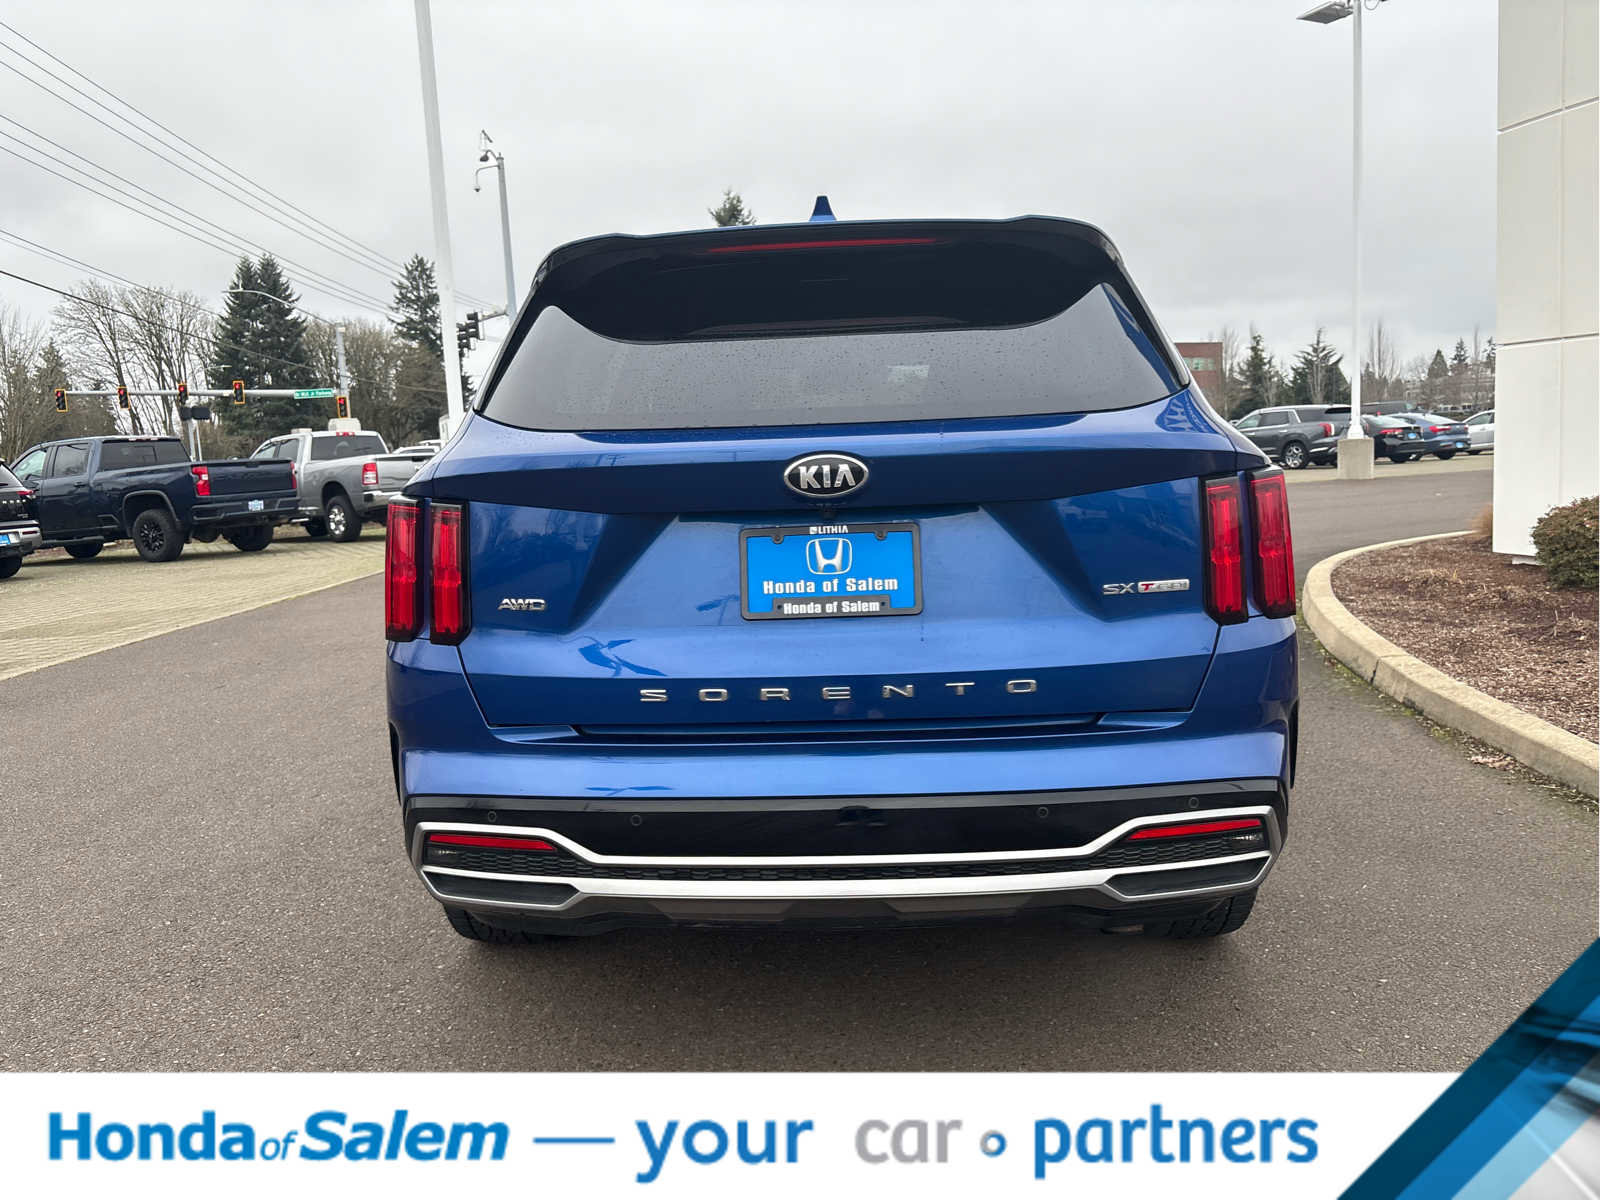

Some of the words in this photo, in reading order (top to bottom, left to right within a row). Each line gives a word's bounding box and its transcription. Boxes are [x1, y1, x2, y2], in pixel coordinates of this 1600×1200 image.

[798, 463, 856, 489] KIA
[818, 525, 848, 534] LITHIA
[763, 580, 815, 594] Honda
[822, 578, 839, 592] of
[846, 577, 898, 591] Salem
[1102, 582, 1135, 595] SX
[498, 598, 546, 611] AWD
[783, 602, 822, 615] Honda
[825, 602, 838, 613] of
[842, 601, 880, 612] Salem
[639, 679, 1037, 702] SORENTO
